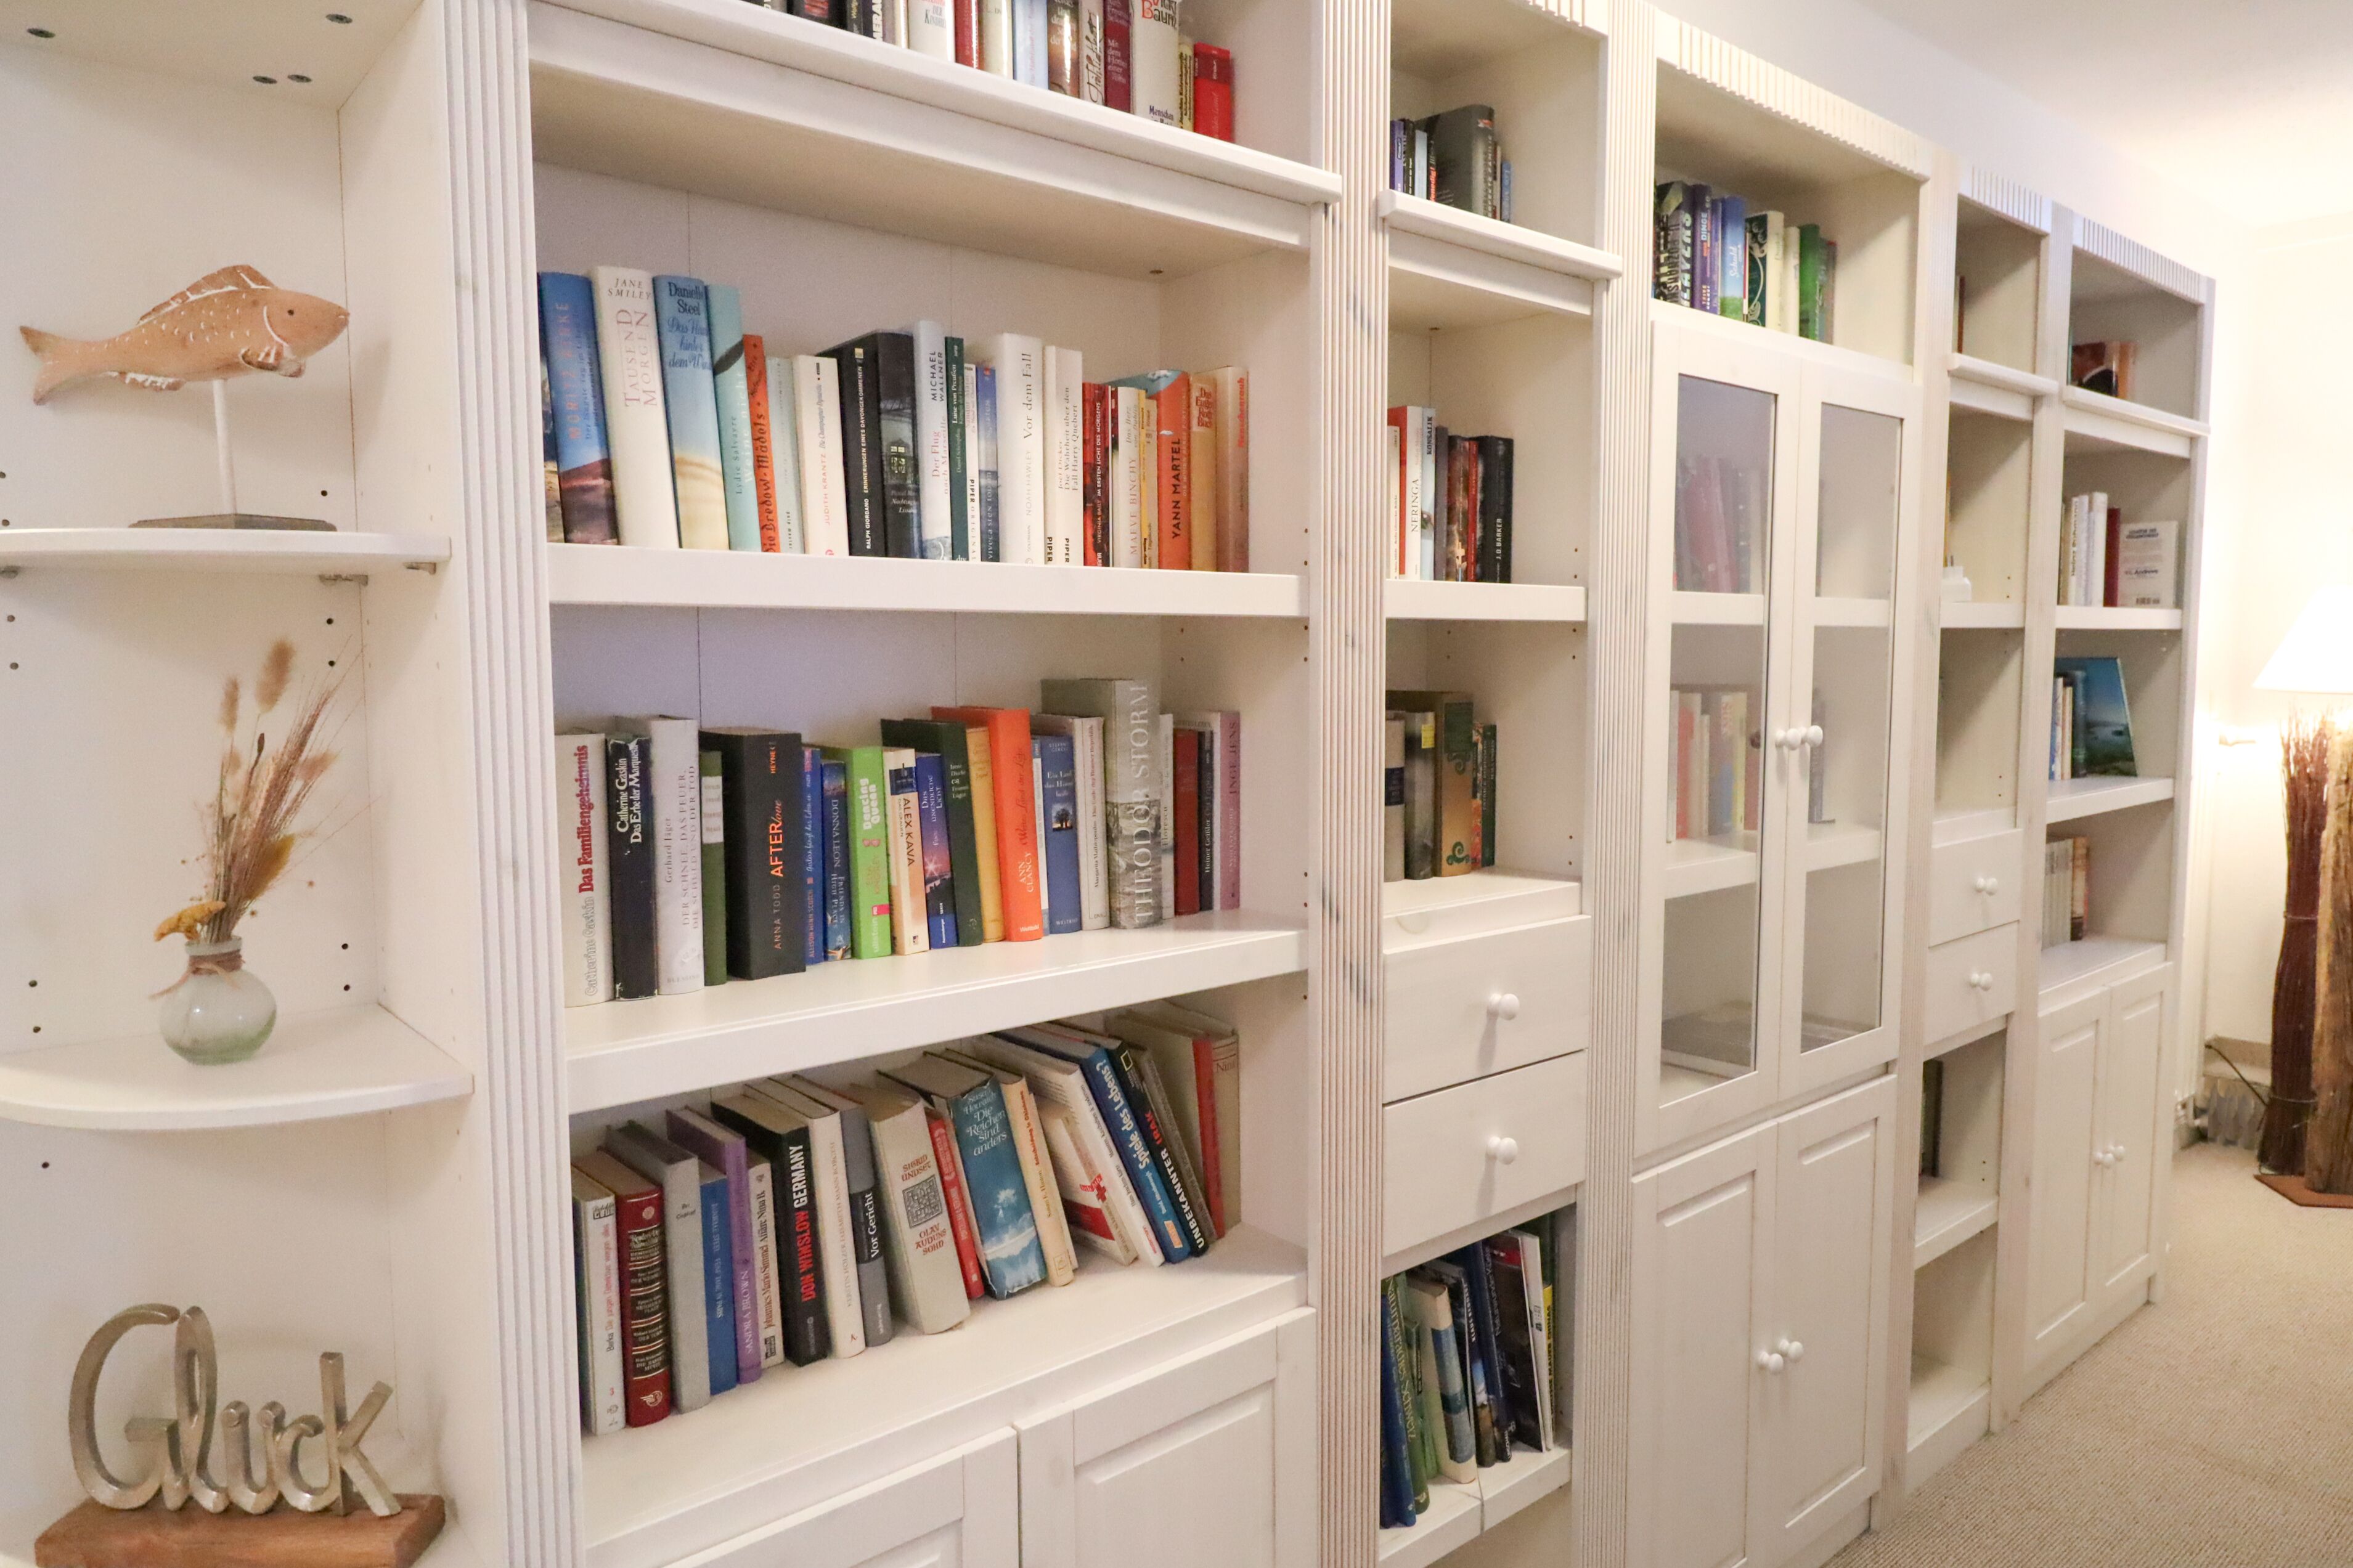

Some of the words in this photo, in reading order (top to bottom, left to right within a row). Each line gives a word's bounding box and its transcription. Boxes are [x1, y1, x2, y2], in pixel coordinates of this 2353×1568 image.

[608, 288, 651, 301] SMILEY
[615, 278, 643, 289] JANE
[677, 299, 701, 316] Steel
[669, 353, 688, 368] dem
[929, 351, 937, 402] MICHAEL
[1021, 352, 1032, 378] Fall
[734, 368, 749, 420] nicht
[857, 365, 866, 428] DAVONGEKOMMENEN
[1022, 383, 1032, 412] dem
[730, 416, 740, 463] Salvayre
[1022, 416, 1034, 439] Vor
[1071, 404, 1079, 442] Quebert
[741, 431, 754, 484] Weine
[931, 430, 941, 454] Flug
[940, 415, 949, 467] Marseille
[861, 448, 869, 494] ERINNERUNGEN
[931, 457, 940, 478] Der
[1024, 450, 1032, 485] HAWLEY
[1071, 445, 1080, 472] Harry
[1171, 438, 1181, 495] MARTEL
[733, 465, 743, 495] Lydie
[1129, 458, 1138, 505] BINCHY
[1172, 500, 1182, 540] YANN
[1411, 478, 1419, 532] NERINGA
[1129, 512, 1138, 555] MAEVE
[1130, 685, 1149, 781] STORM
[1228, 721, 1238, 754] JENS
[615, 758, 628, 790] Gaskin
[1048, 771, 1058, 779] Ein
[1229, 763, 1238, 794] INGE
[574, 744, 594, 867] Familiengeheimnis
[630, 789, 642, 802] der
[860, 778, 872, 830] Dancing
[869, 784, 880, 824] Queen
[616, 792, 629, 833] Catherine
[630, 802, 642, 824] Erbe
[831, 800, 840, 837] DONNA
[903, 798, 913, 827] ALEX
[630, 824, 642, 843] Das
[680, 819, 688, 842] DAS
[1204, 819, 1212, 845] Geißler
[664, 846, 672, 884] Gerhard
[769, 822, 784, 877] AFTER
[833, 840, 841, 872] LEON
[905, 832, 915, 867] KAVA
[1132, 789, 1153, 924] THEODOR
[578, 869, 595, 893] Das
[1026, 851, 1034, 893] CLANCY
[773, 884, 781, 913] TODD
[582, 896, 597, 937] Gaskin
[773, 917, 782, 950] ANNA
[582, 938, 598, 997] Catherine
[1096, 1059, 1125, 1111] Lebens?
[966, 1110, 1007, 1137] Reichen
[973, 1107, 993, 1122] Die
[1120, 1110, 1135, 1132] des
[1144, 1110, 1163, 1145] IRAK
[973, 1131, 1008, 1156] anders
[979, 1123, 1000, 1143] sind
[902, 1155, 928, 1172] SIGRID
[1129, 1132, 1150, 1169] Spiele
[789, 1144, 808, 1208] GERMANY
[901, 1162, 931, 1182] UNDSET
[834, 1177, 842, 1201] MANN
[1160, 1147, 1205, 1249] UNBEKANNTER
[757, 1199, 767, 1218] Nina
[864, 1191, 878, 1235] Gericht
[794, 1209, 815, 1273] WINSLOW
[915, 1230, 947, 1249] AUDUNS
[919, 1223, 940, 1238] OLAV
[759, 1243, 770, 1272] Simmel
[870, 1237, 880, 1258] Vor
[741, 1270, 752, 1311] BROWN
[761, 1272, 772, 1294] Mario
[801, 1274, 816, 1302] DON
[763, 1295, 775, 1330] Johannes
[743, 1312, 753, 1355] SANDRA
[1400, 1382, 1417, 1442] Schweiz
